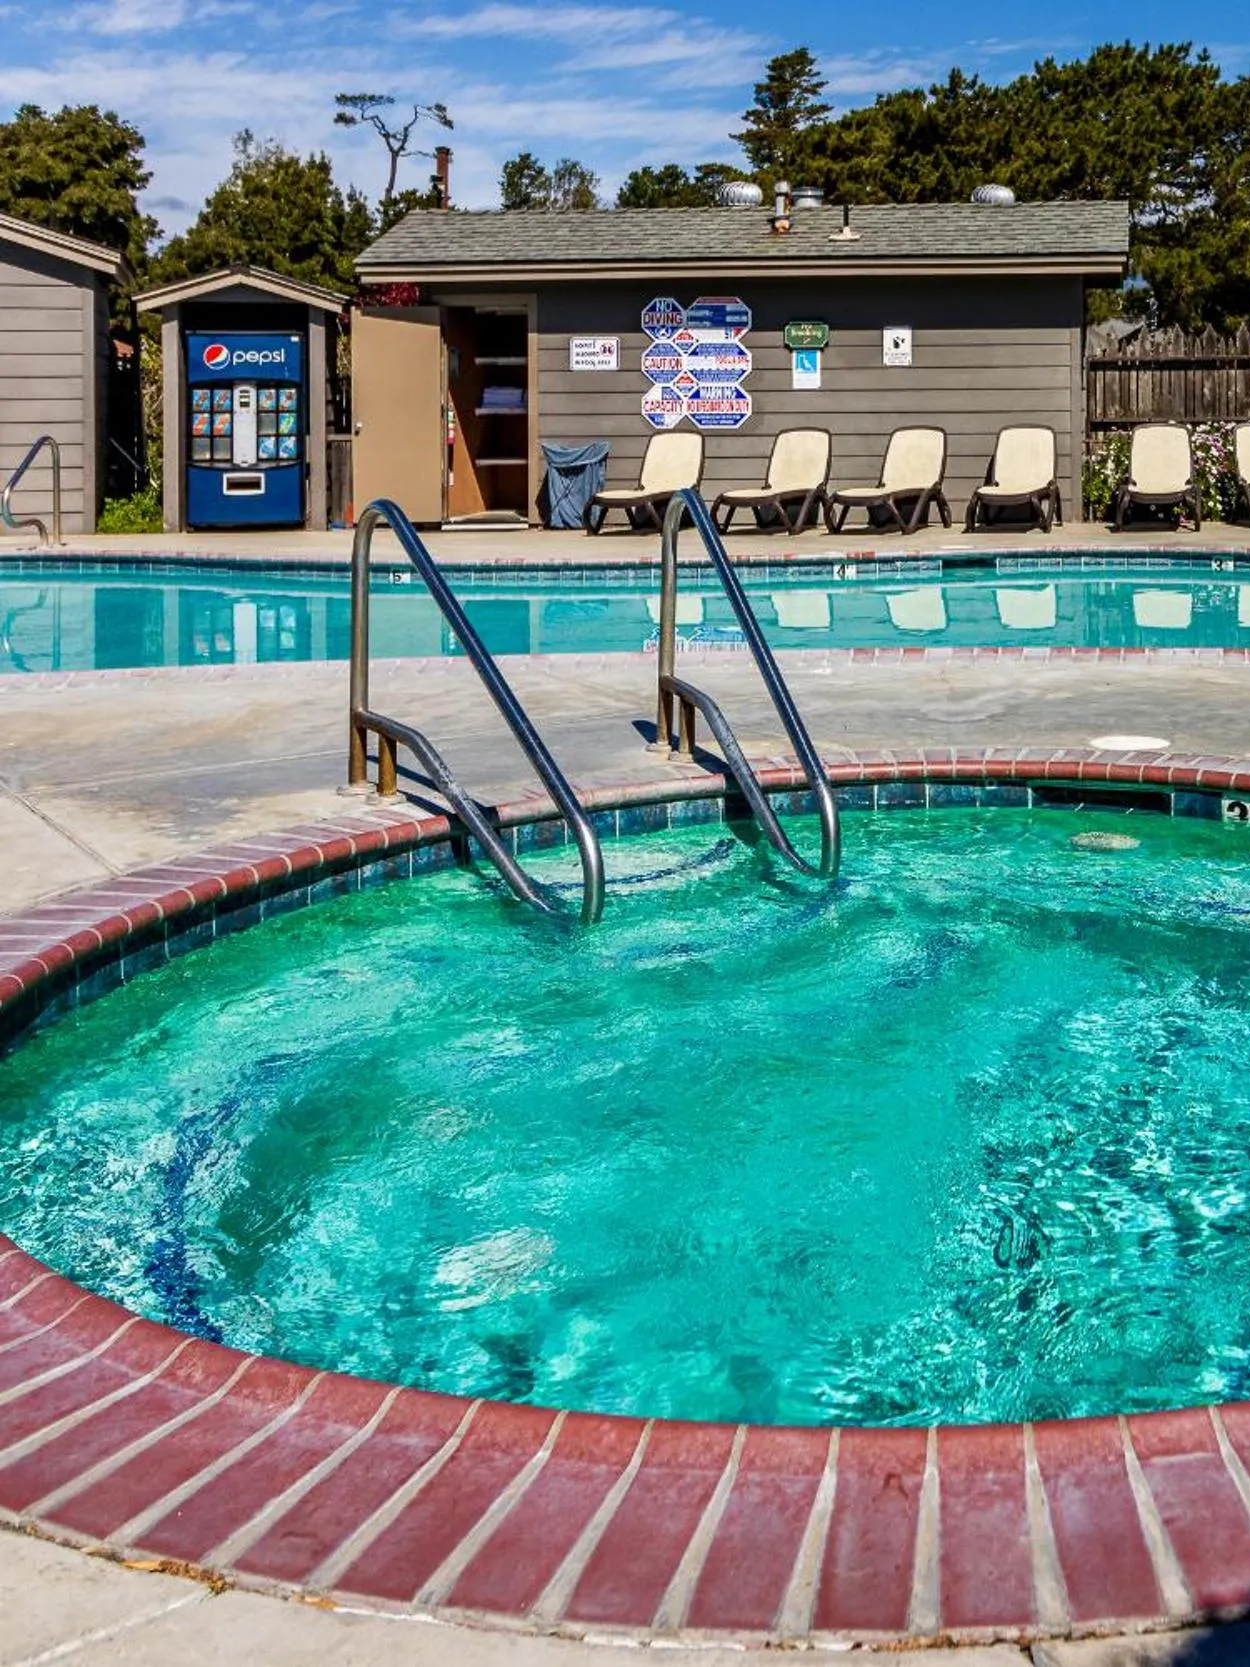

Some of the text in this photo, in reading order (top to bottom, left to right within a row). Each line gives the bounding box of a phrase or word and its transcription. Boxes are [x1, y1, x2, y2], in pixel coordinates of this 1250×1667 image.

[656, 299, 672, 312] NO
[643, 312, 683, 325] DIVING
[233, 347, 285, 366] pepsi
[644, 358, 682, 369] CAUTION
[644, 400, 684, 412] CAPACITY
